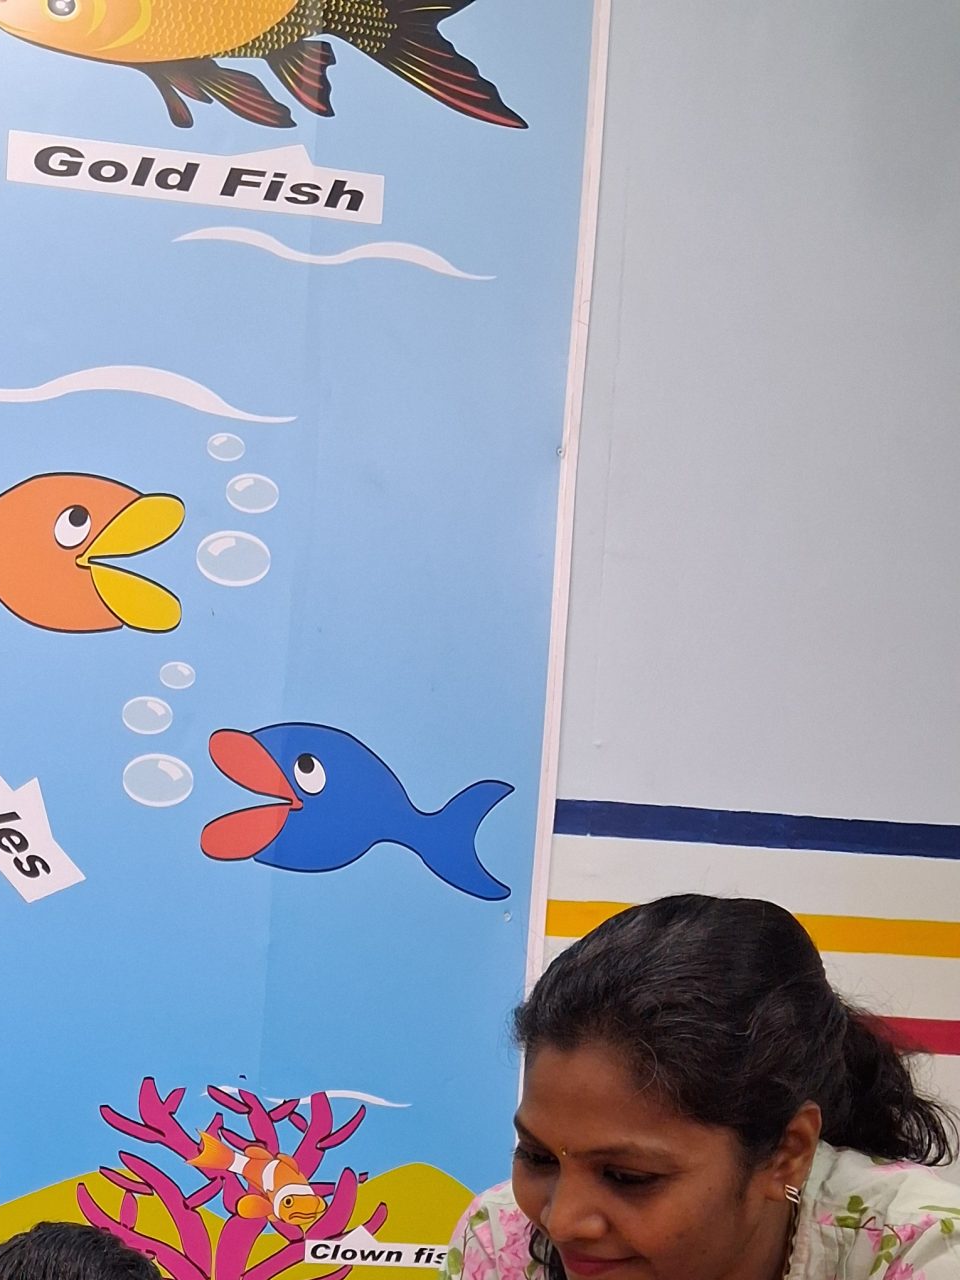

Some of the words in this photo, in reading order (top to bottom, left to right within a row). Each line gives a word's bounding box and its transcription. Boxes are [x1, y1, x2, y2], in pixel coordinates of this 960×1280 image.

[33, 145, 200, 192] Gold
[219, 167, 365, 212] Fish
[310, 1243, 403, 1263] Clown
[414, 1247, 448, 1265] fis
